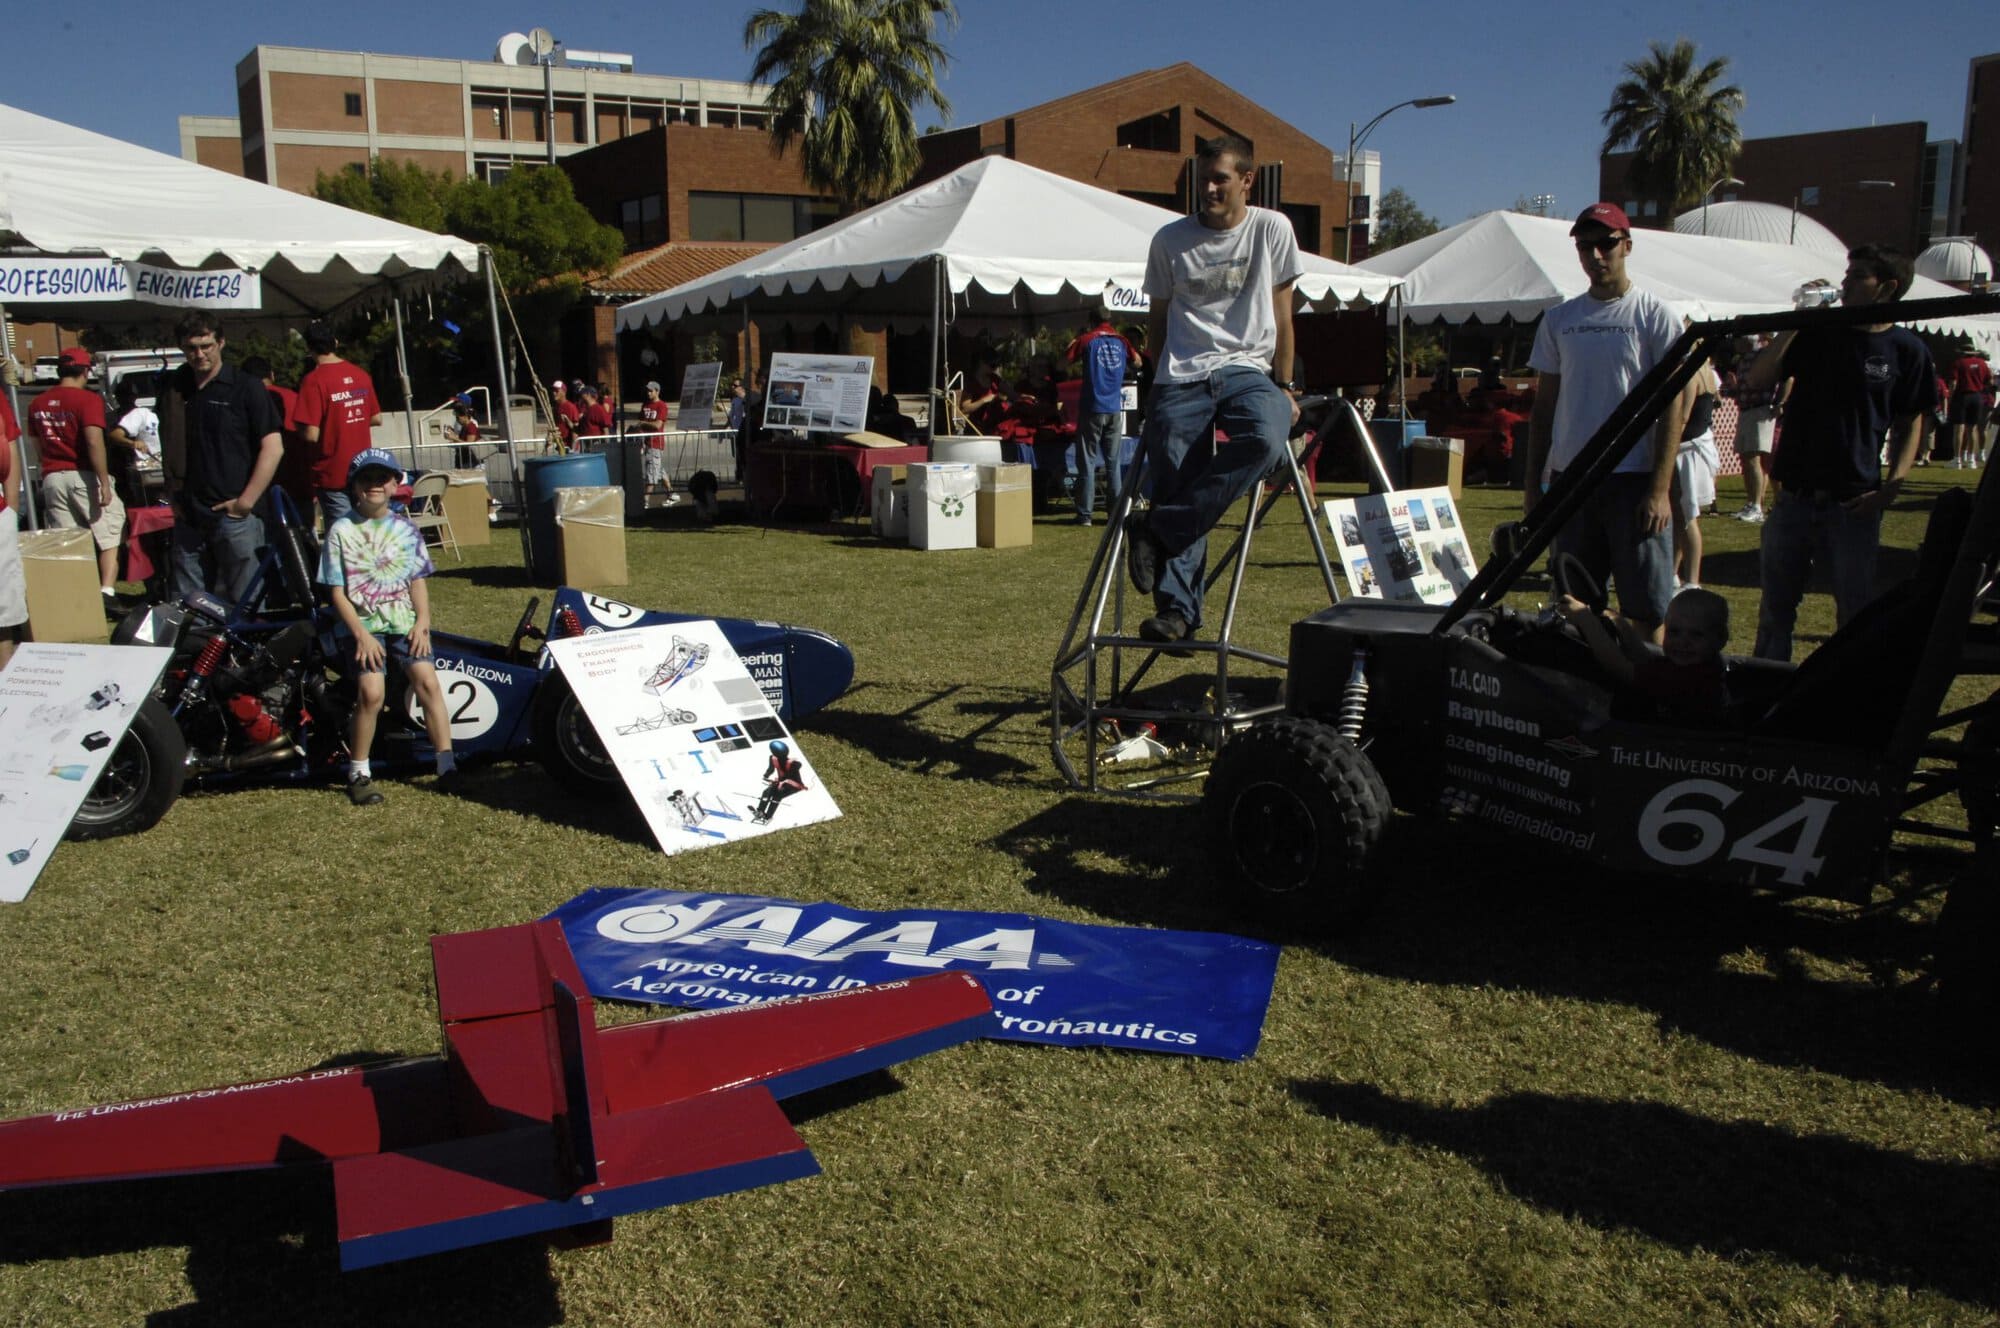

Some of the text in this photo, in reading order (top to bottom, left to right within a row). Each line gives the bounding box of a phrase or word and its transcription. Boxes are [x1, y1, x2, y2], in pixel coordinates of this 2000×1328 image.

[136, 272, 242, 298] ENGINEERS
[353, 448, 391, 467] NEW YORK
[1392, 505, 1409, 517] SAE
[435, 658, 513, 685] OF ARIZONA
[1473, 672, 1500, 698] CAID
[1448, 700, 1540, 737] Raytheon
[1445, 733, 1572, 788] azengineering
[1480, 799, 1596, 850] International
[1638, 778, 1840, 886] 64
[676, 906, 1036, 970] AIAA
[639, 958, 818, 989] American
[997, 986, 1044, 1005] of
[310, 1067, 355, 1081] DBF
